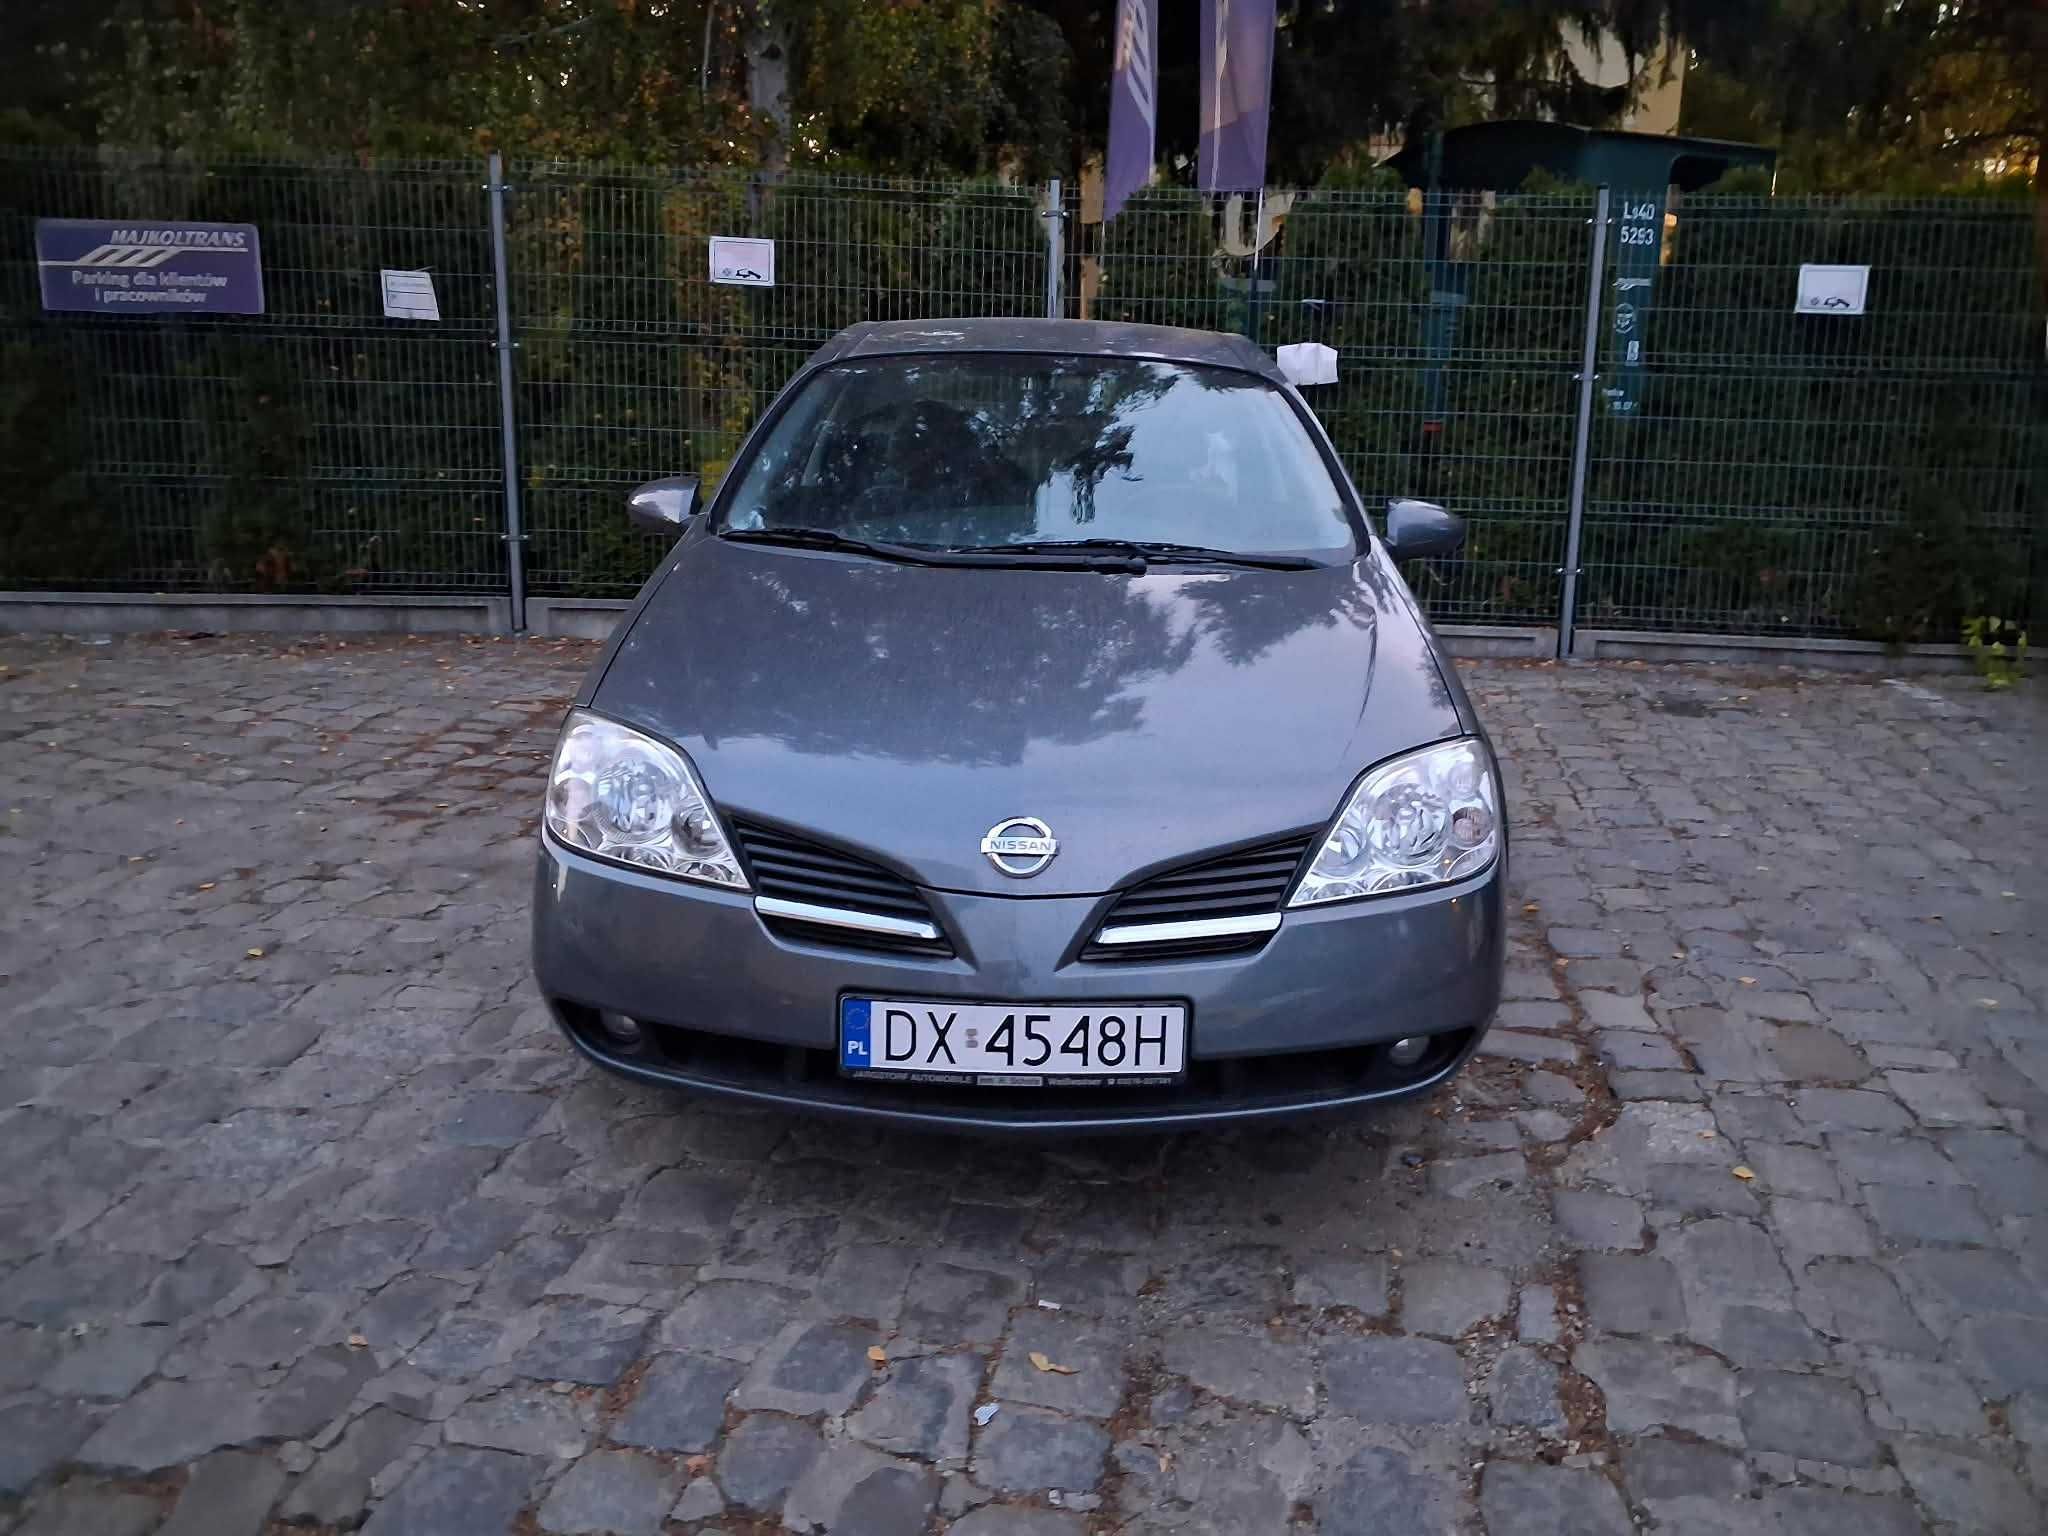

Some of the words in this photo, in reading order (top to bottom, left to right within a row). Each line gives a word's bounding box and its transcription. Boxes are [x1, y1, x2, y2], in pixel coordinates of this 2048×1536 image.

[110, 230, 246, 247] MAJKOLTRANS
[72, 270, 130, 288] Parking
[133, 271, 156, 286] dla
[160, 271, 228, 287] klientów
[103, 288, 207, 304] pracowników
[990, 840, 1051, 851] NISSAN
[885, 1009, 958, 1065] DX
[984, 1014, 1169, 1068] 4548H
[847, 1040, 868, 1056] PL
